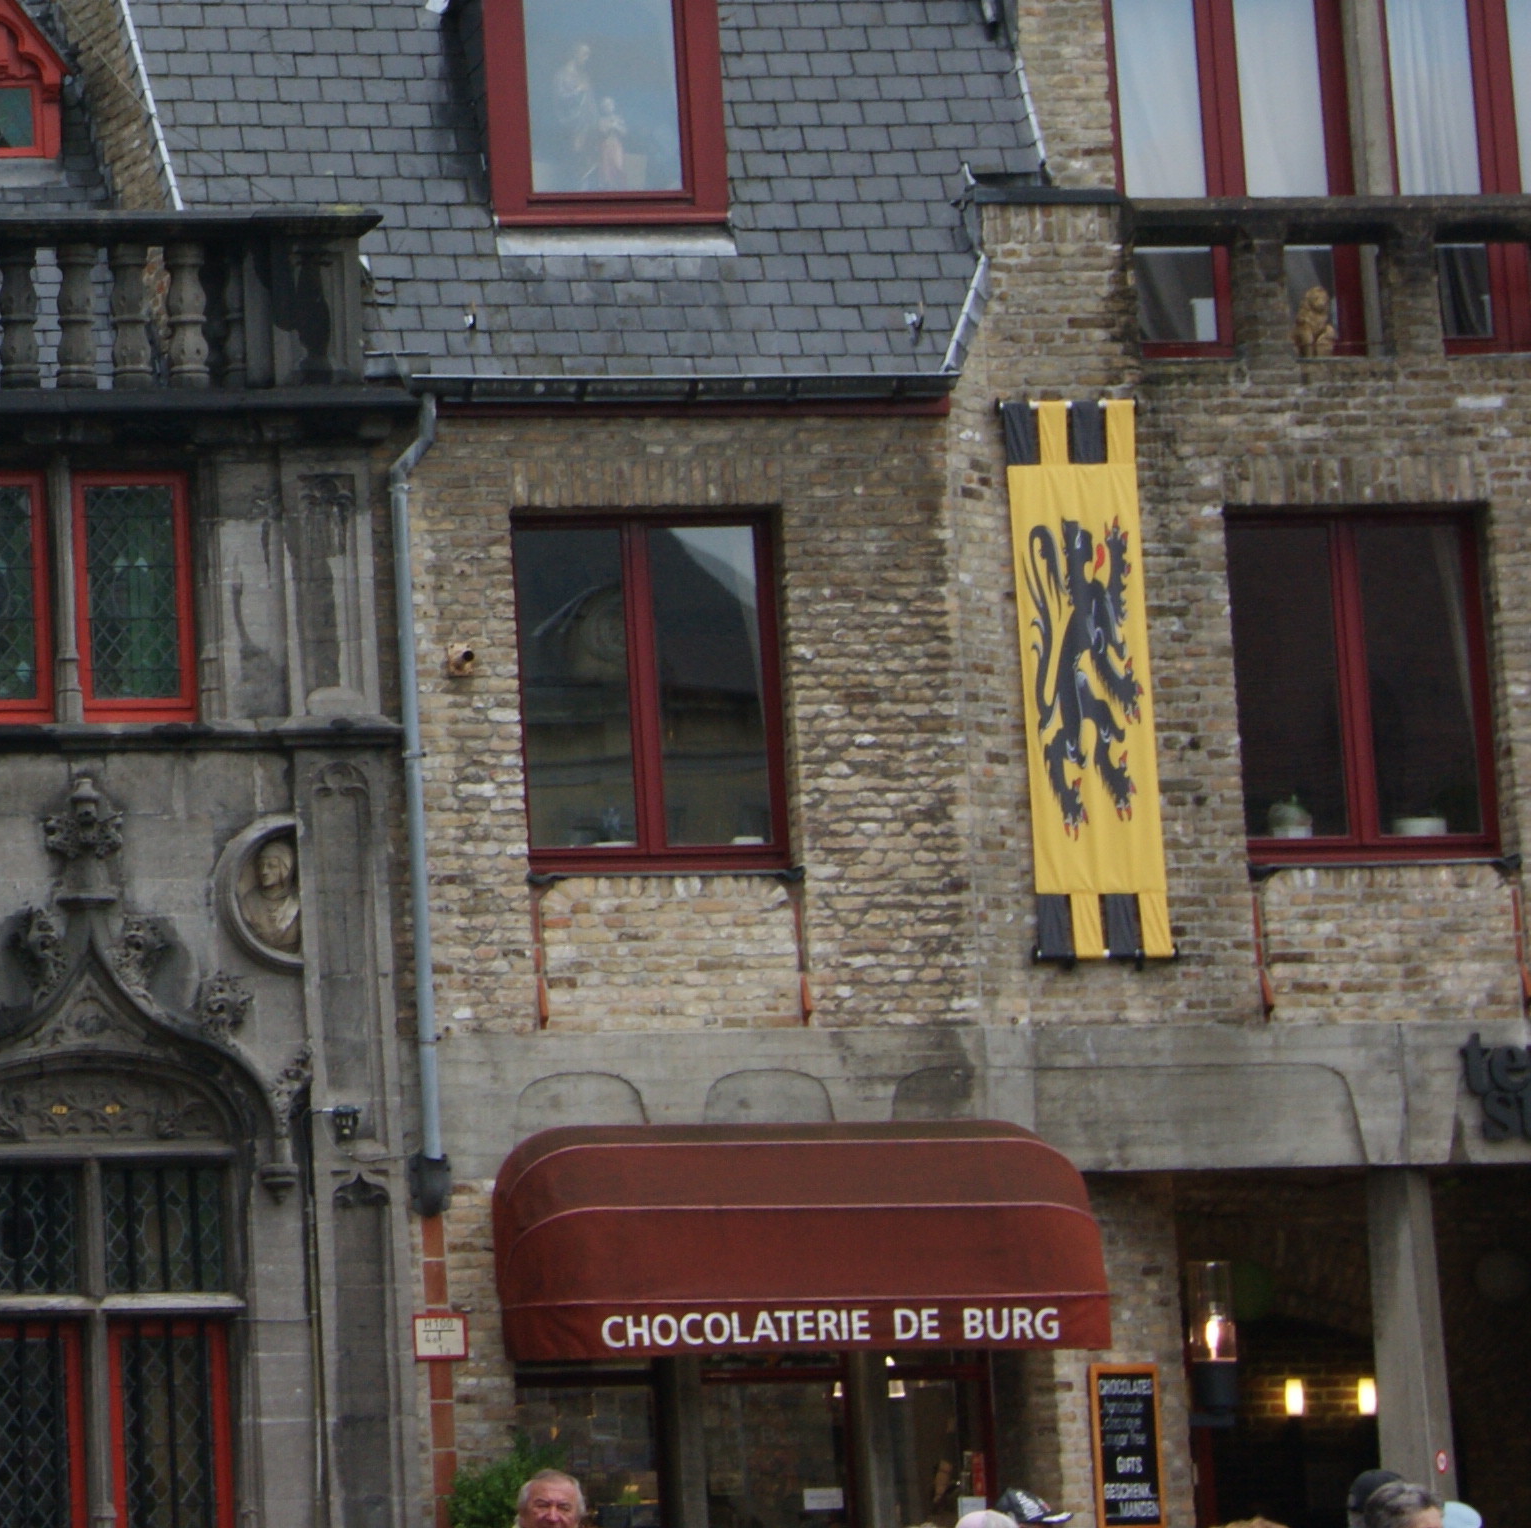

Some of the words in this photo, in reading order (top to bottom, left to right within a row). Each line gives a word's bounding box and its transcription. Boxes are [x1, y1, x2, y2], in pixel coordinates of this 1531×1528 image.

[601, 1308, 871, 1349] CHOCOLATERIE
[894, 1307, 940, 1340] DE
[963, 1307, 1060, 1341] BURG
[1099, 1379, 1152, 1395] CHOCOLATES
[1117, 1457, 1143, 1473] GIFTS
